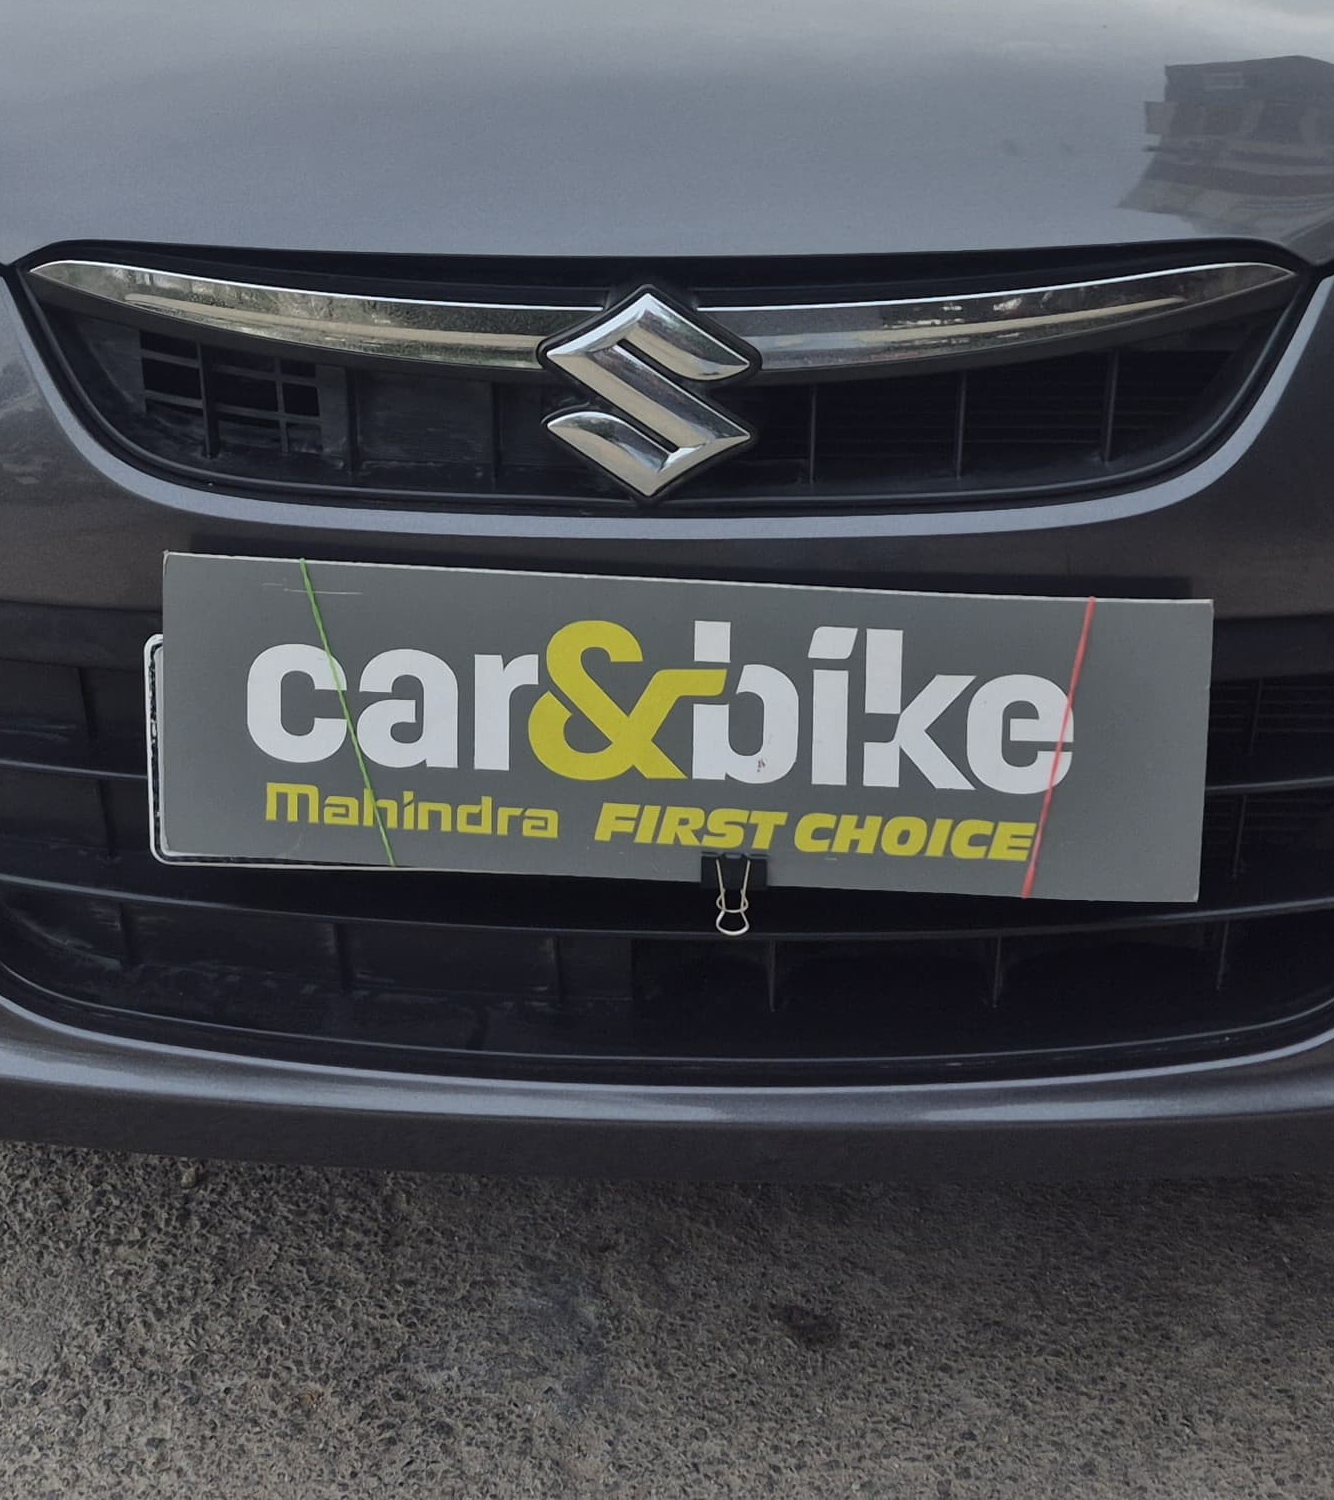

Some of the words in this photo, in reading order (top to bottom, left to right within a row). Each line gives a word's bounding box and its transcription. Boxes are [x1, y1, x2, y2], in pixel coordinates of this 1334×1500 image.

[246, 619, 1074, 796] car&bike
[265, 782, 560, 840] Mahindra
[594, 803, 789, 851] FIRST
[793, 813, 1039, 862] CHOICE
